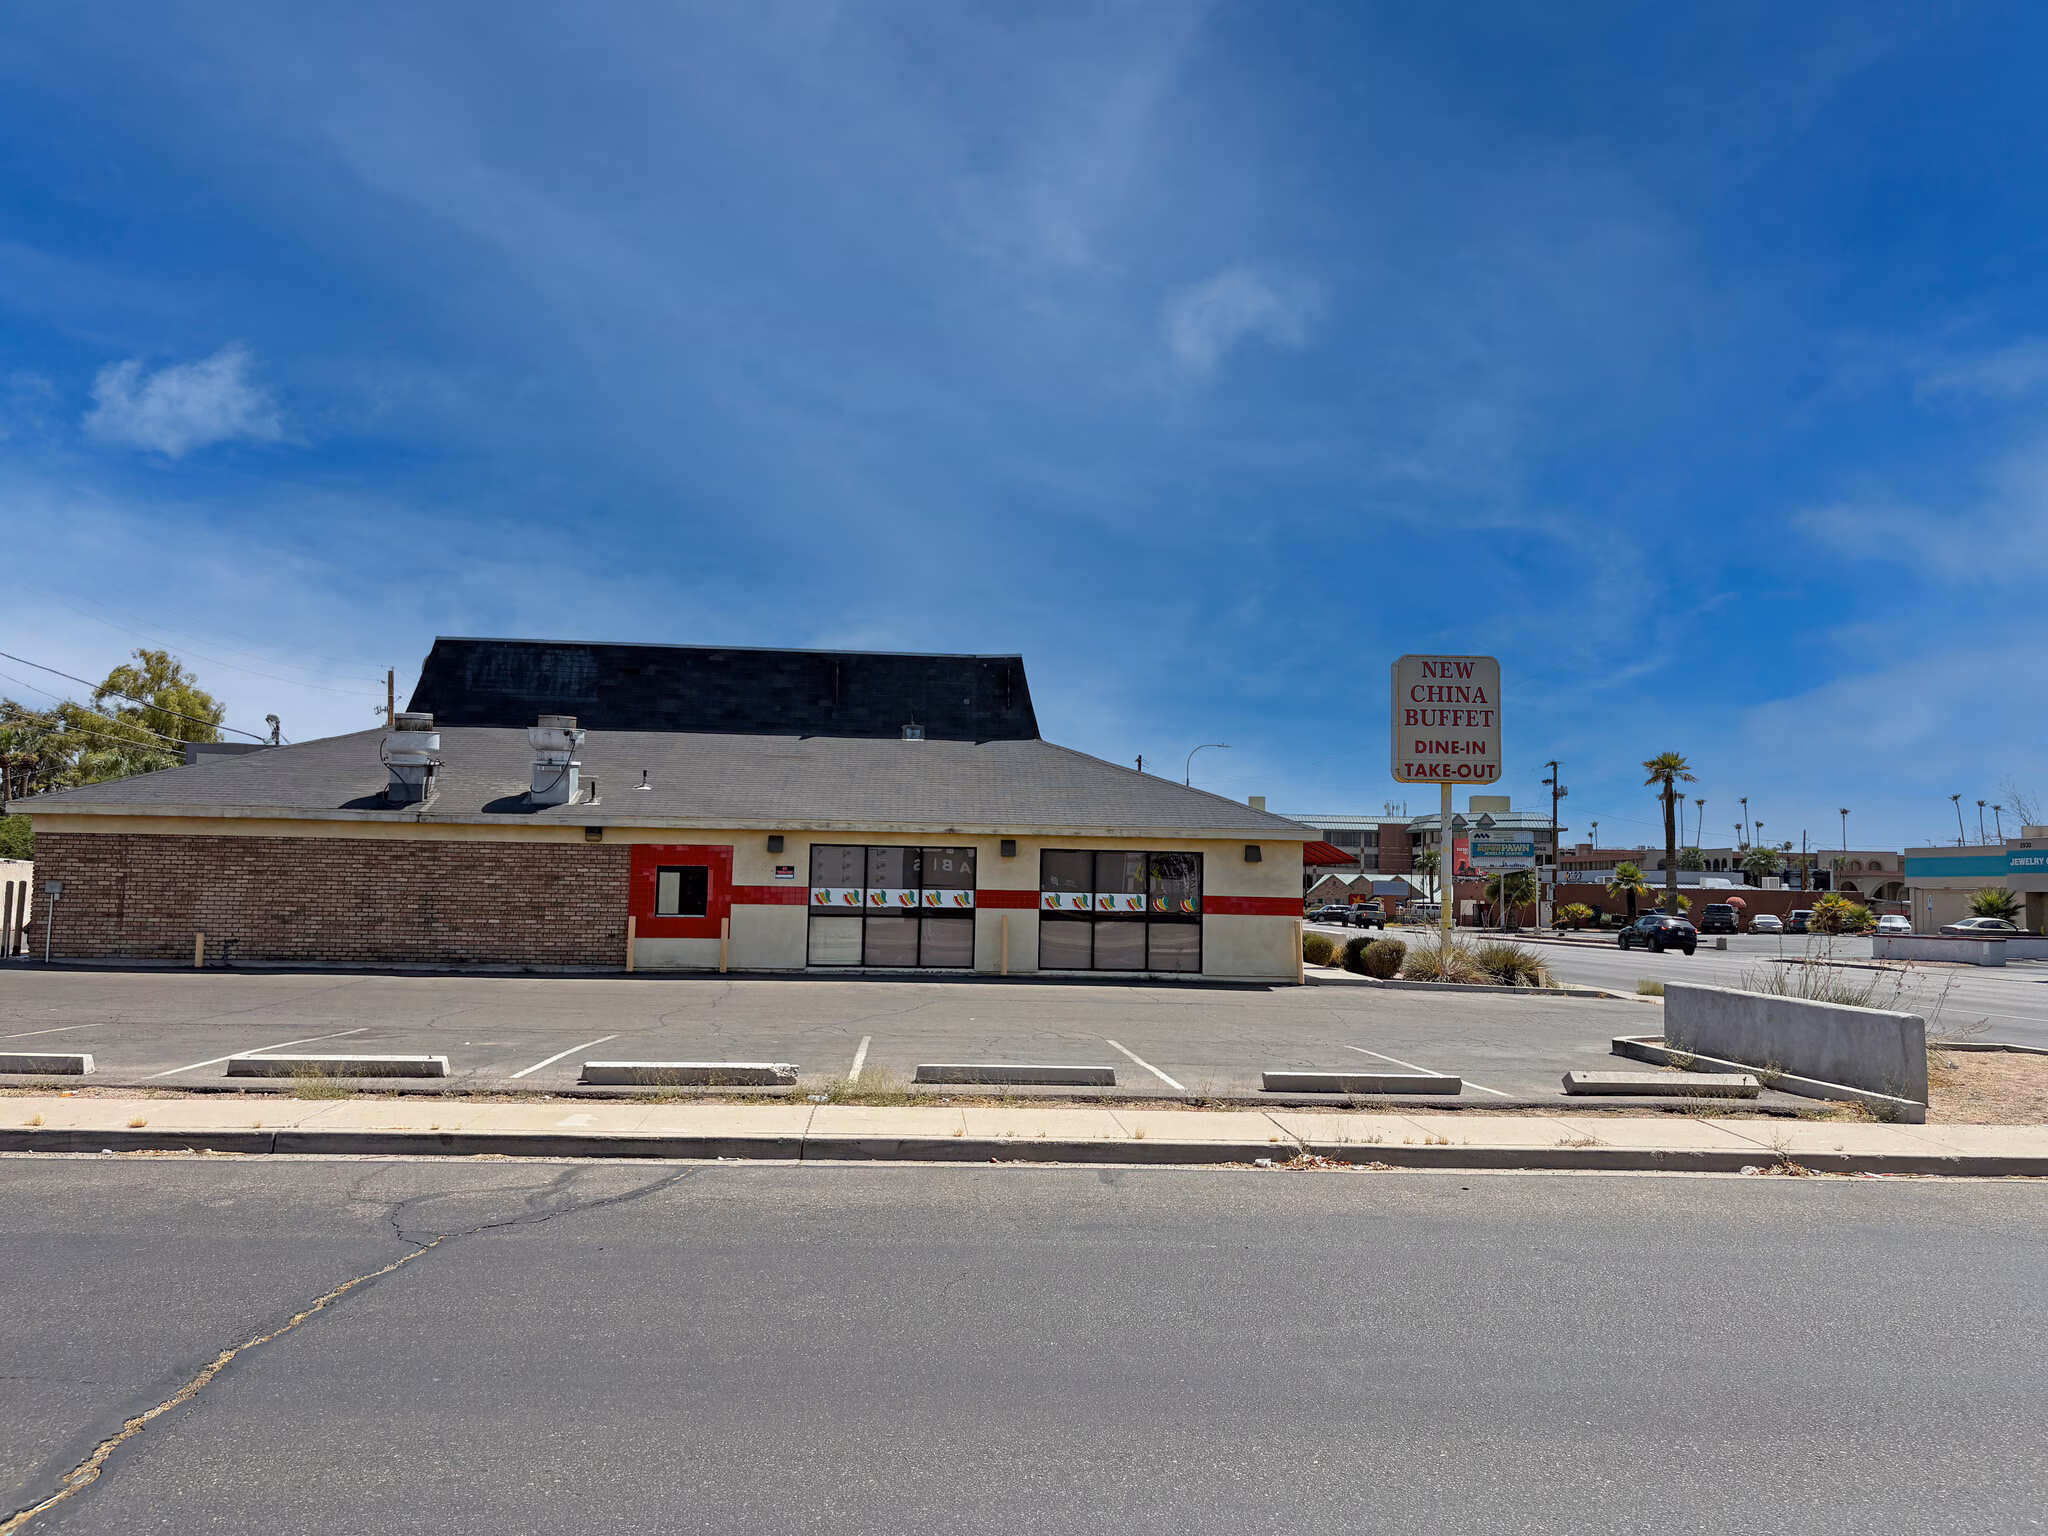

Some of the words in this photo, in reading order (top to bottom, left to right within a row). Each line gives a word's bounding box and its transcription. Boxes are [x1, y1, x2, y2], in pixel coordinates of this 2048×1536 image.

[1421, 661, 1475, 679] NEW
[1410, 685, 1488, 704] CHINA
[1404, 709, 1494, 727] BUFFET
[1415, 740, 1486, 755] DINE-IN
[1404, 763, 1496, 778] TAKE-OUT
[2009, 857, 2044, 866] JEWELRY
